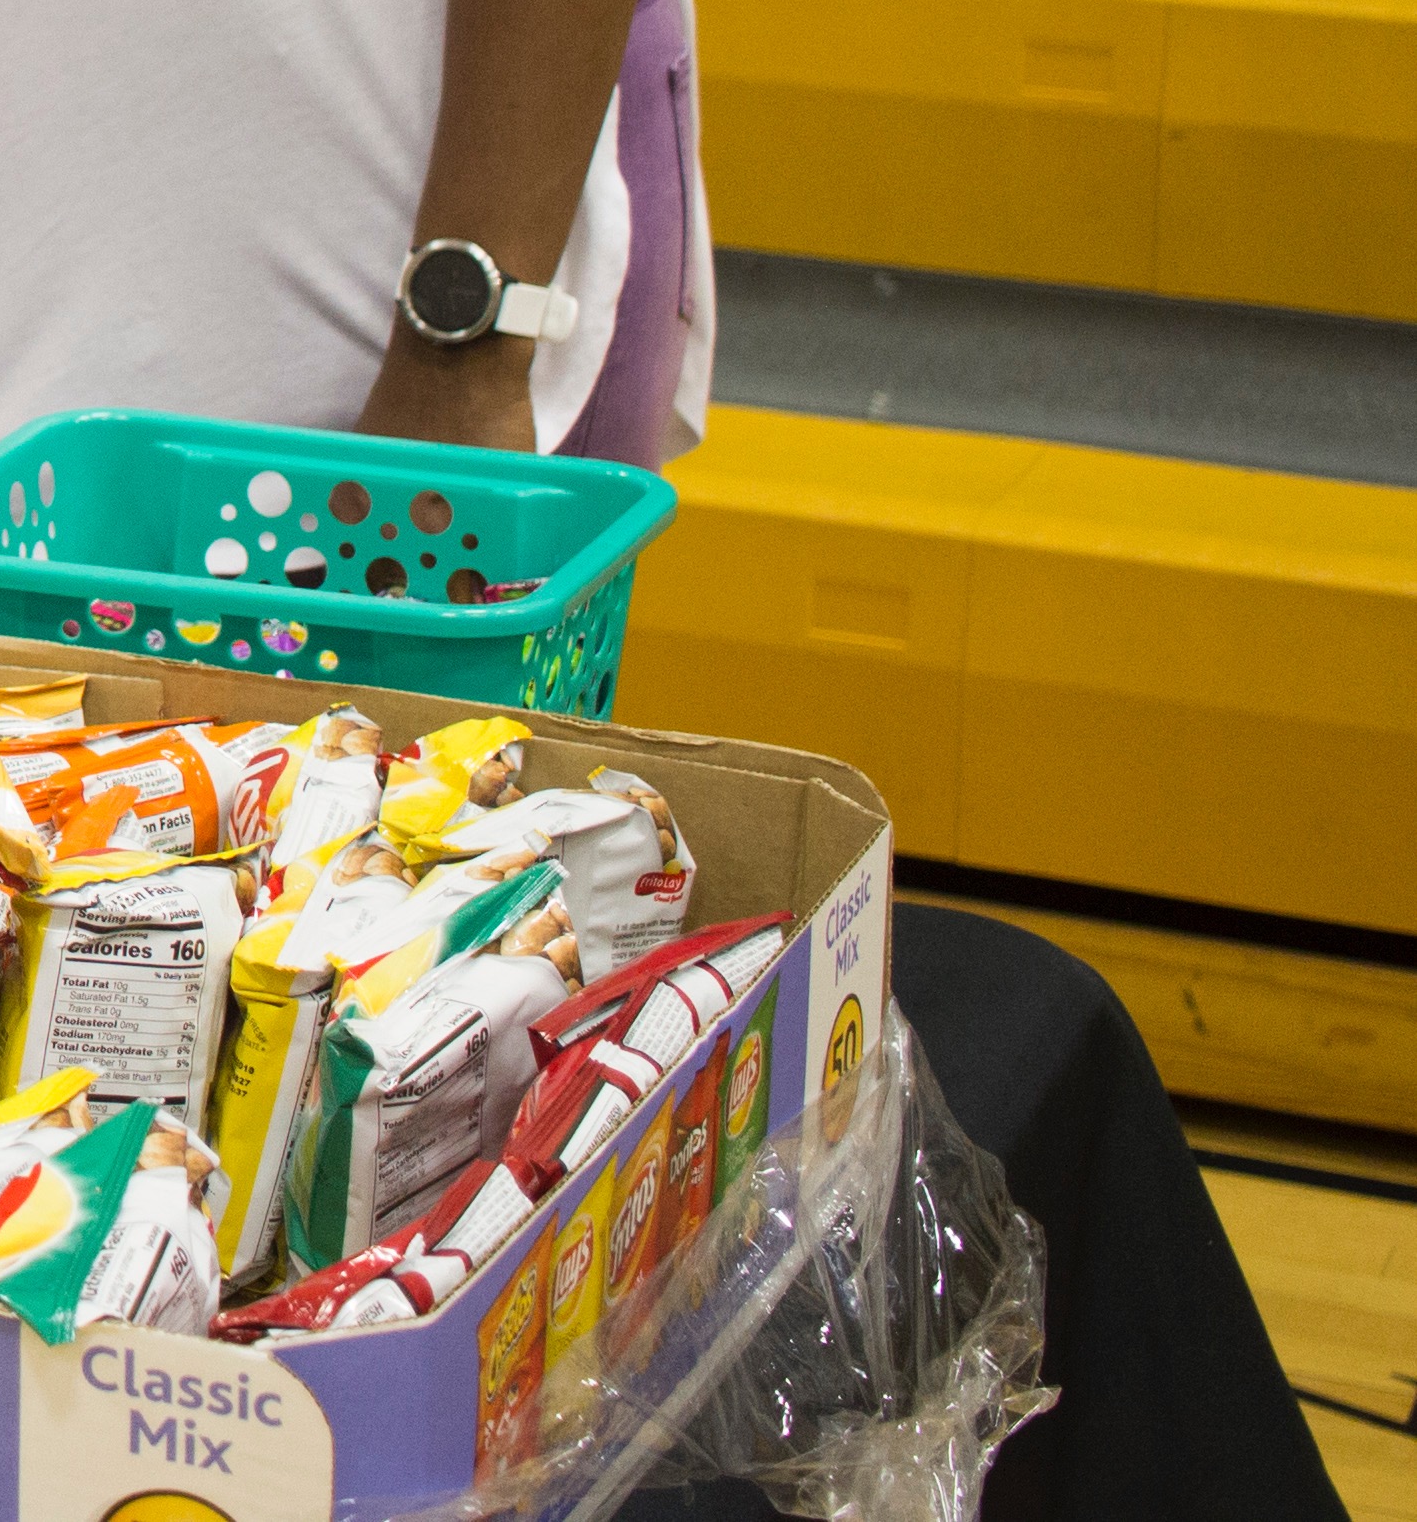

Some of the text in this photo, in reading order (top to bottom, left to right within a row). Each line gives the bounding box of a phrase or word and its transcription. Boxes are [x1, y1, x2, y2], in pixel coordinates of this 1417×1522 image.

[160, 812, 191, 831] Facts
[78, 907, 200, 925] Serving size package
[826, 870, 872, 950] Classic
[67, 939, 205, 961] Calories 160
[835, 931, 860, 988] Mix
[62, 977, 200, 992] Total Fat 10g 13%
[163, 971, 183, 980] Daily
[69, 990, 198, 1006] Saturated Fat 1.5g 7%
[68, 1004, 122, 1018] Trans Fat 0g
[55, 1016, 196, 1032] Cholesterol 0mg 0%
[52, 1028, 194, 1044] Sodium 170mg 7%
[465, 1027, 489, 1058] 160
[51, 1041, 191, 1058] Total Carbohydrate 15g 6%
[833, 1020, 856, 1075] 50
[59, 1055, 190, 1069] Dietary Fiber 1g 5%
[112, 1072, 162, 1083] less than 1g
[384, 1071, 444, 1100] Calories
[729, 1046, 758, 1119] Lay's
[383, 1117, 405, 1130] Total
[669, 1117, 708, 1185] Doritos
[609, 1158, 657, 1285] Fritos
[166, 1246, 192, 1279] 160
[553, 1237, 591, 1311] Lay's
[82, 1346, 282, 1427] Classic
[129, 1408, 233, 1474] Mix
